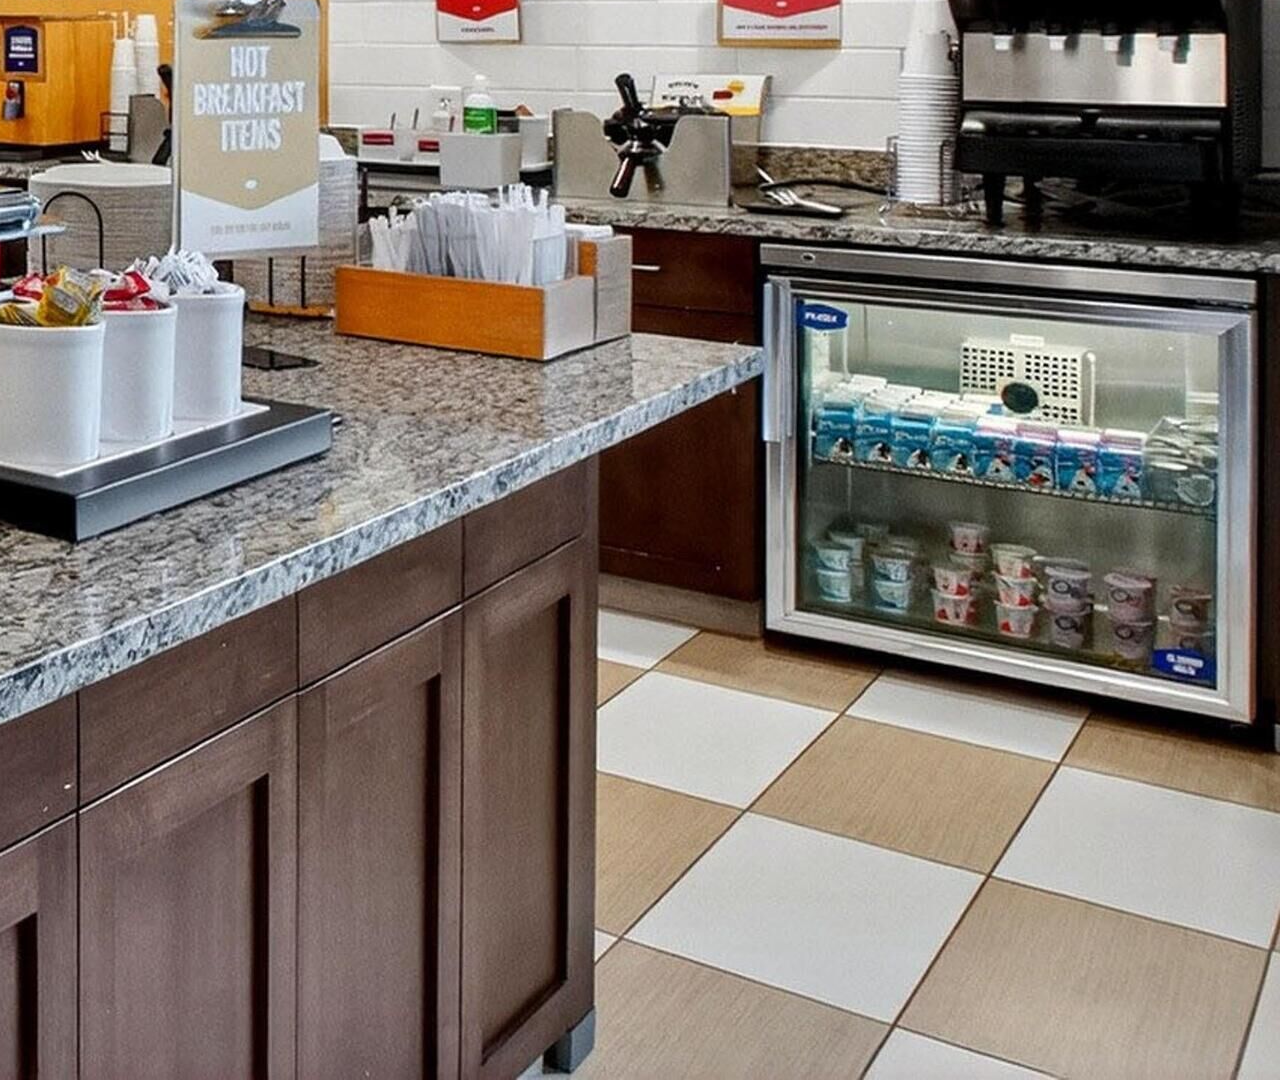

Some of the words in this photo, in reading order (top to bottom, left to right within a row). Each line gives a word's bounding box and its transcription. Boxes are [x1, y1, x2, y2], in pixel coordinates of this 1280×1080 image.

[230, 46, 271, 78] HOT
[193, 81, 307, 116] BREAKFAST
[220, 119, 282, 152] ITEMS
